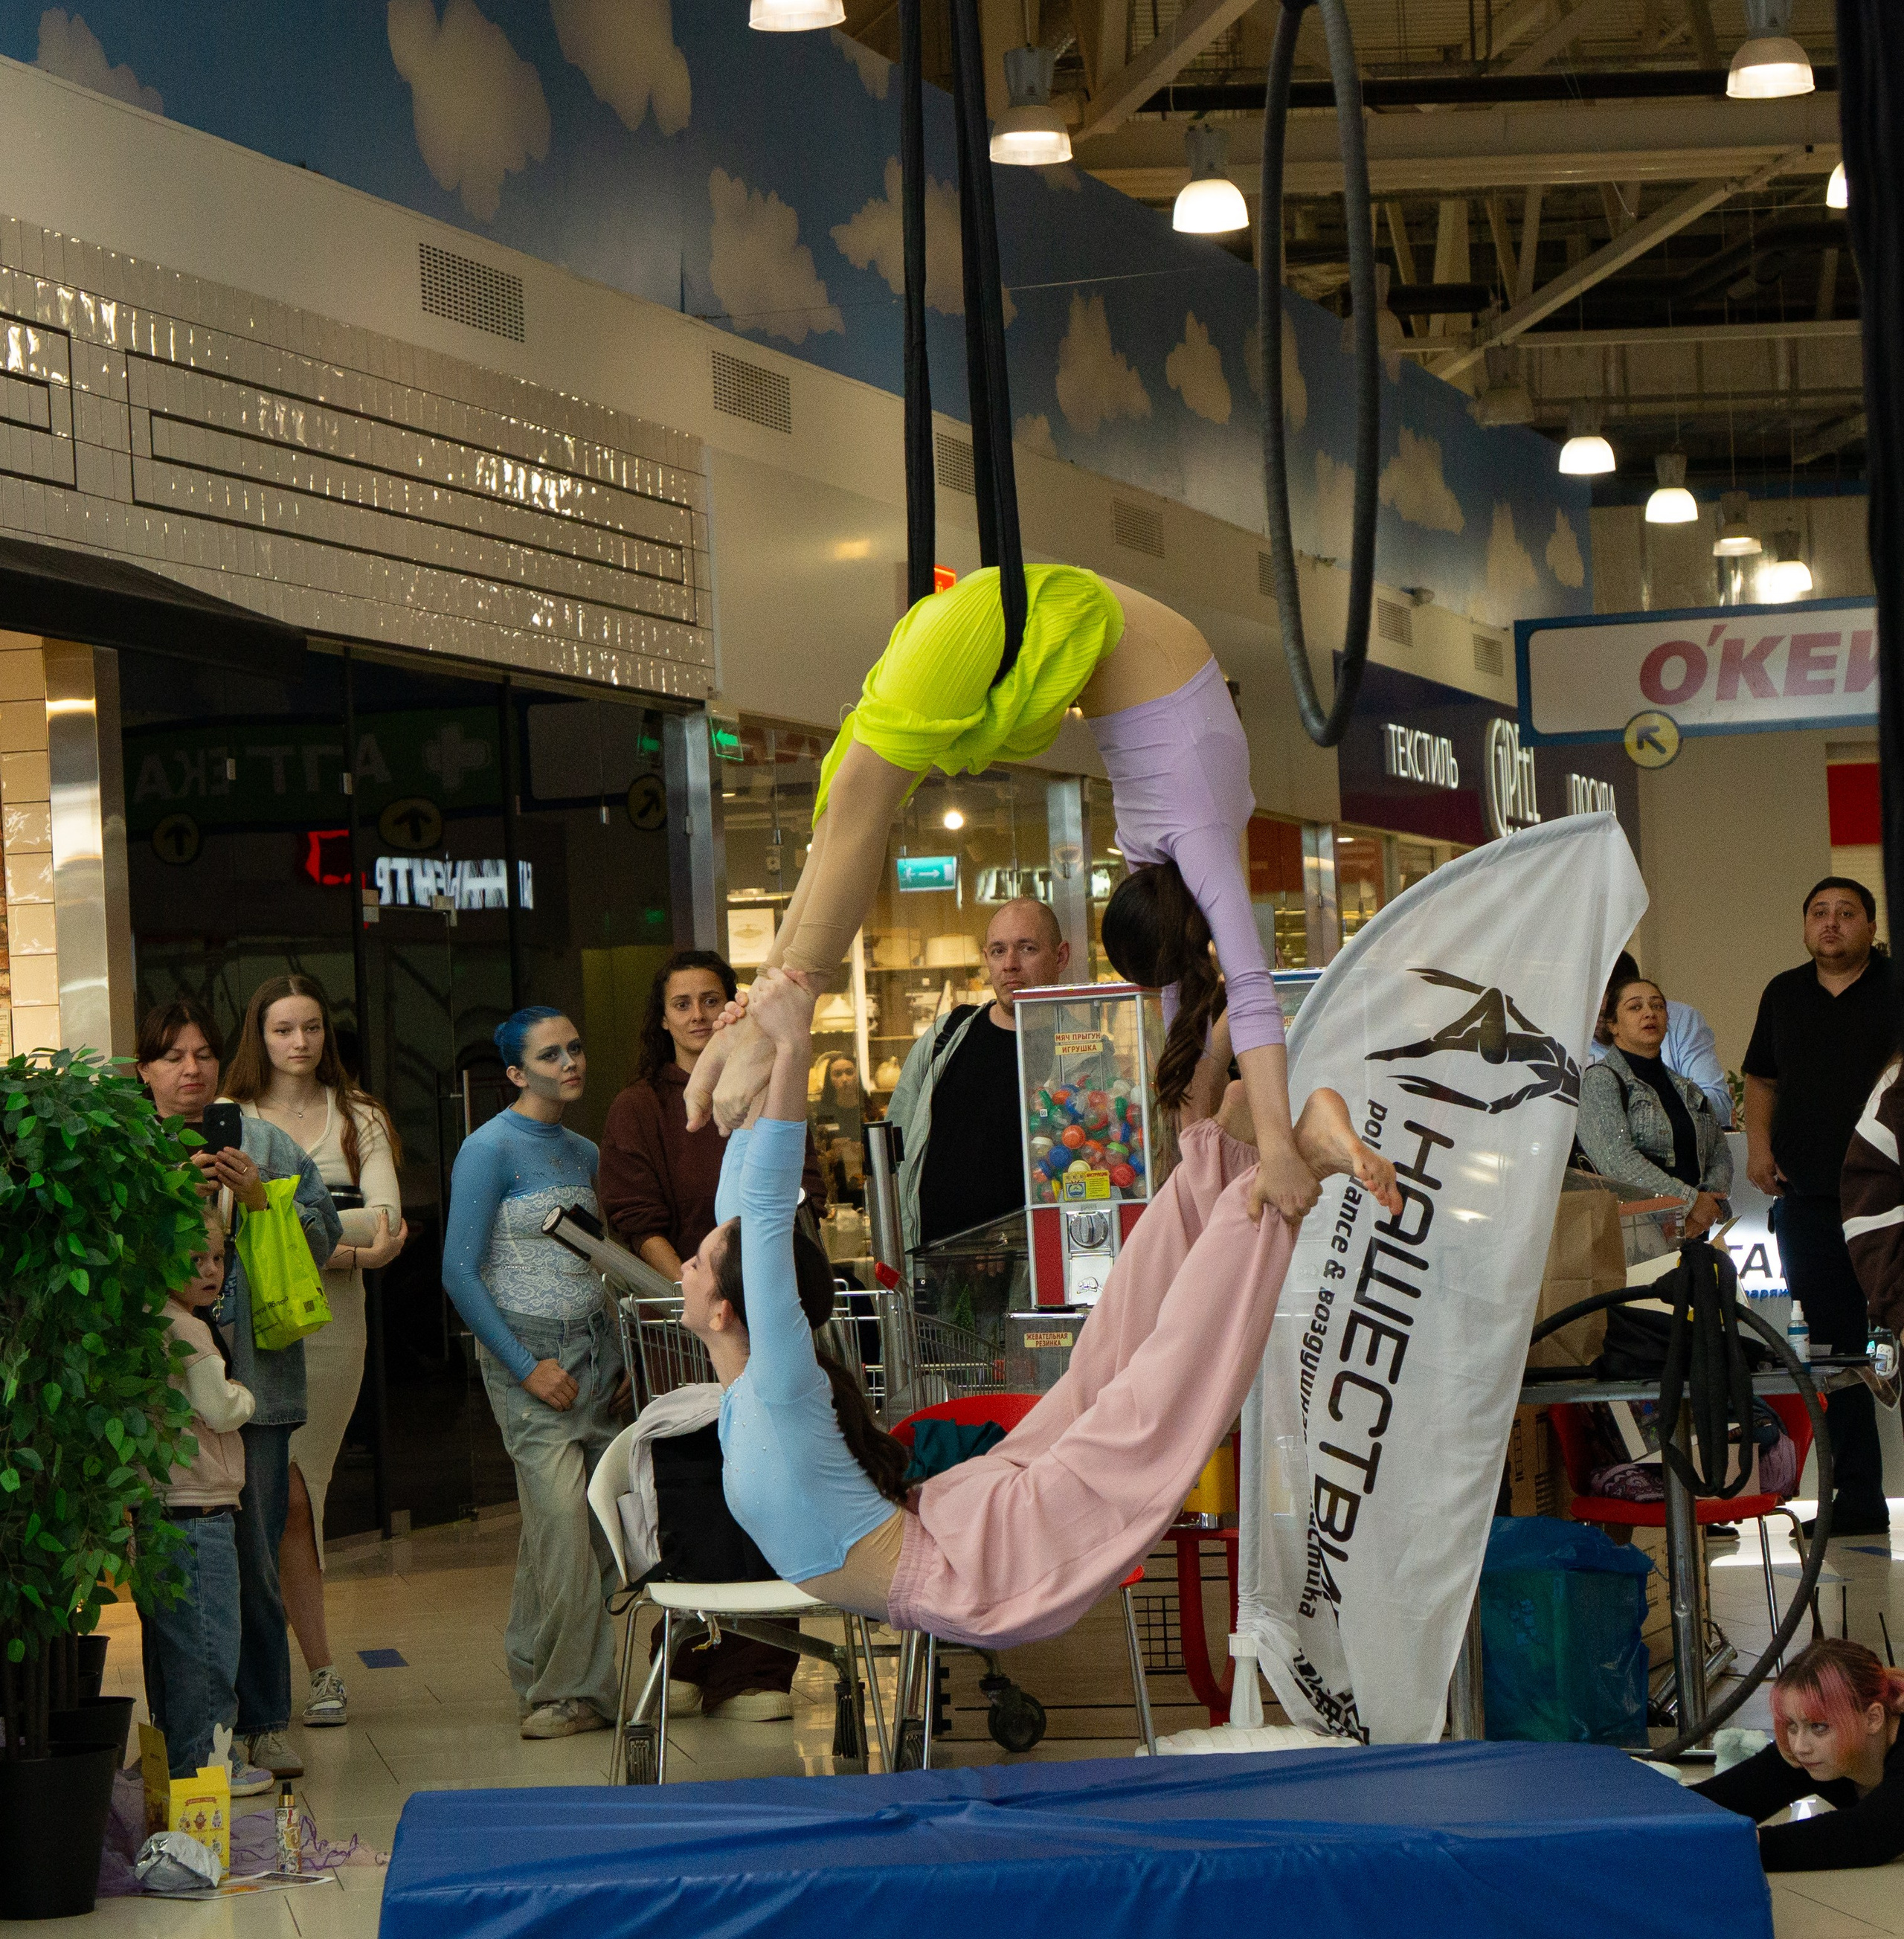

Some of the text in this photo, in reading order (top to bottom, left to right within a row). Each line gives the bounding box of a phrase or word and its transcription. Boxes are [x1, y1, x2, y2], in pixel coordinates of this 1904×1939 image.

[1387, 723, 1459, 789] ТЕКСТИЛЬ
[1055, 1032, 1101, 1042] МЯЧ ПРЫГУН
[1062, 1044, 1097, 1053] ИГРУШКА
[1361, 1099, 1388, 1151] pol
[1322, 1258, 1346, 1280] &
[1298, 1286, 1336, 1445] воздушн
[1314, 1119, 1456, 1630] НАШЕСТВИ
